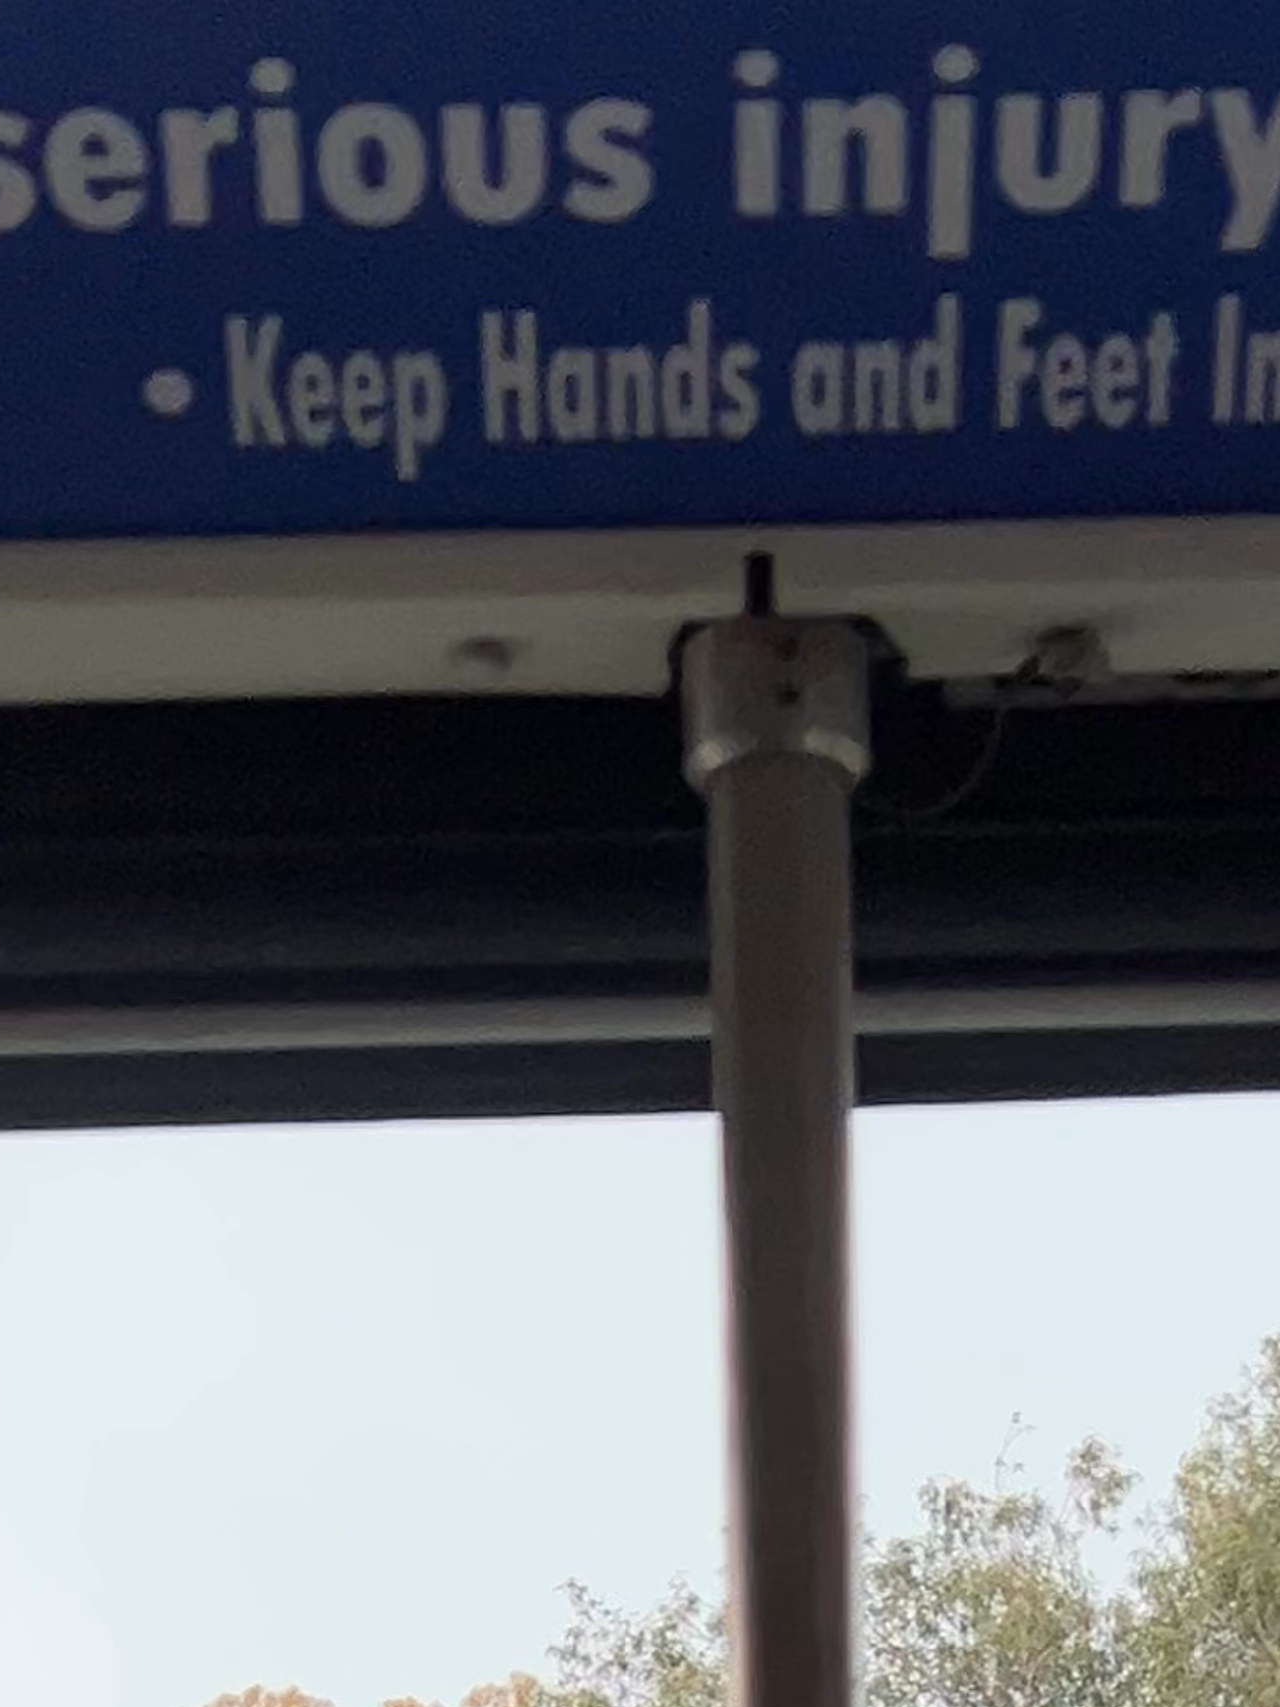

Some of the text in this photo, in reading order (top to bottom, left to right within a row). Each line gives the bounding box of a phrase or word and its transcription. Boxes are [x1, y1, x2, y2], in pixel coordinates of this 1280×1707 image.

[224, 314, 448, 482] Keep
[480, 297, 761, 443] Hands
[790, 292, 961, 435] and
[996, 297, 1180, 431] Feet
